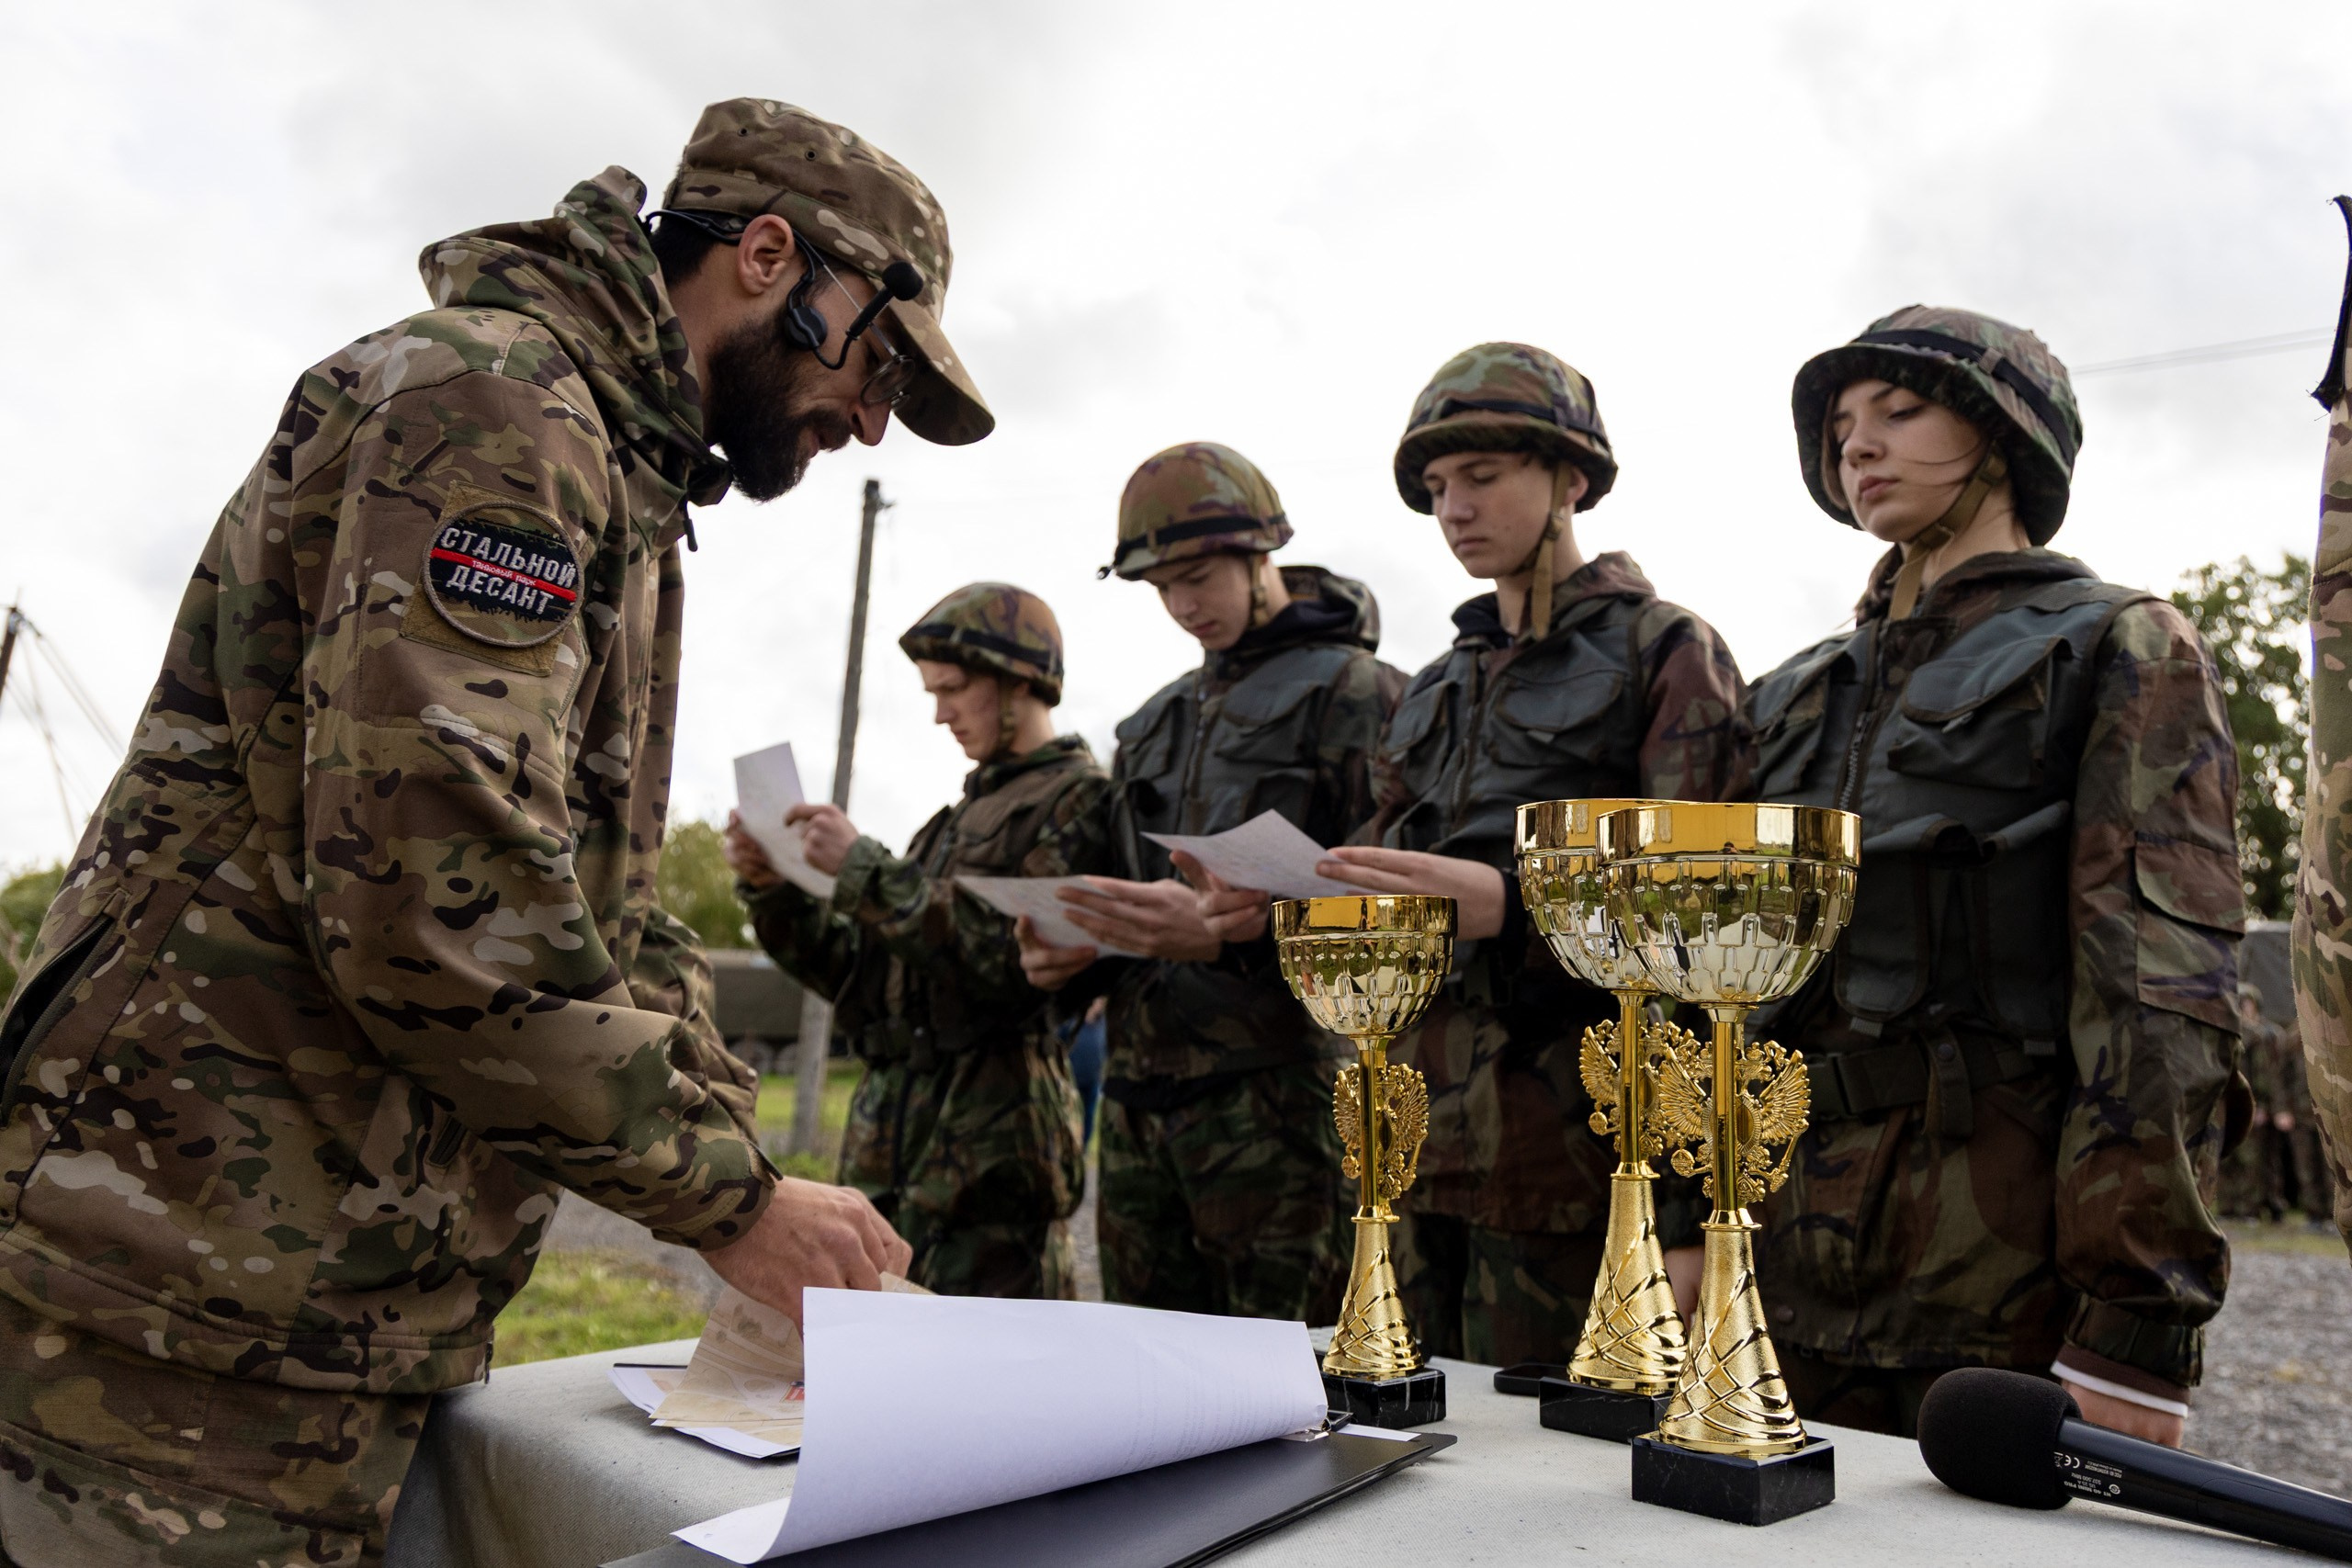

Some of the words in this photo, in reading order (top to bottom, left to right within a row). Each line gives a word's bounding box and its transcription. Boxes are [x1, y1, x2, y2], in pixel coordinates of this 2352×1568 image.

[440, 526, 577, 589] СТАЛЬНОЙ
[514, 573, 537, 587] парк
[445, 564, 554, 615] ДЕСАНТ
